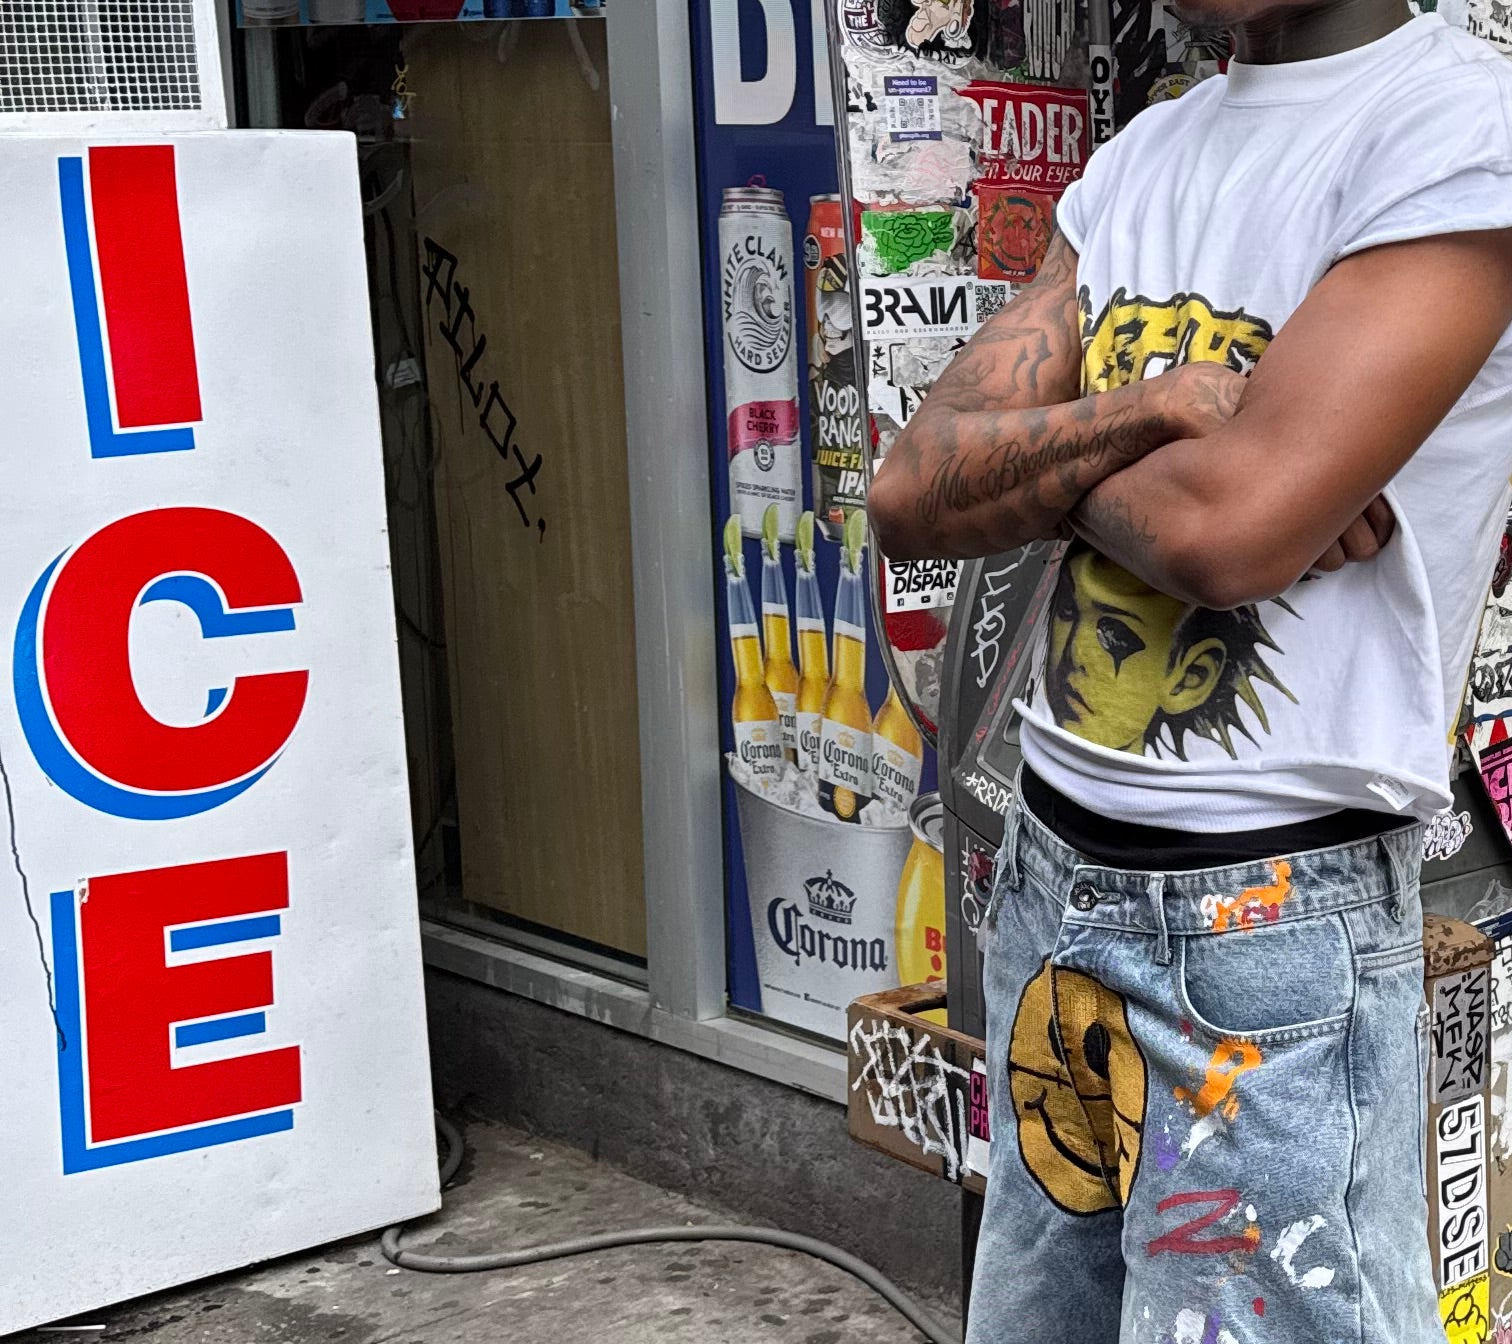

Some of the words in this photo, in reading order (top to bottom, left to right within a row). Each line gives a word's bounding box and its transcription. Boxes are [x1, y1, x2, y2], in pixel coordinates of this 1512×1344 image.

[982, 98, 1084, 164] EADER
[1046, 167, 1081, 184] EYES
[745, 235, 788, 281] CLAW
[734, 336, 762, 367] HARD
[13, 143, 310, 1175] ICE
[741, 738, 781, 763] Corona
[823, 741, 869, 773] Corona
[872, 751, 915, 795] Corona
[767, 896, 888, 975] Corona
